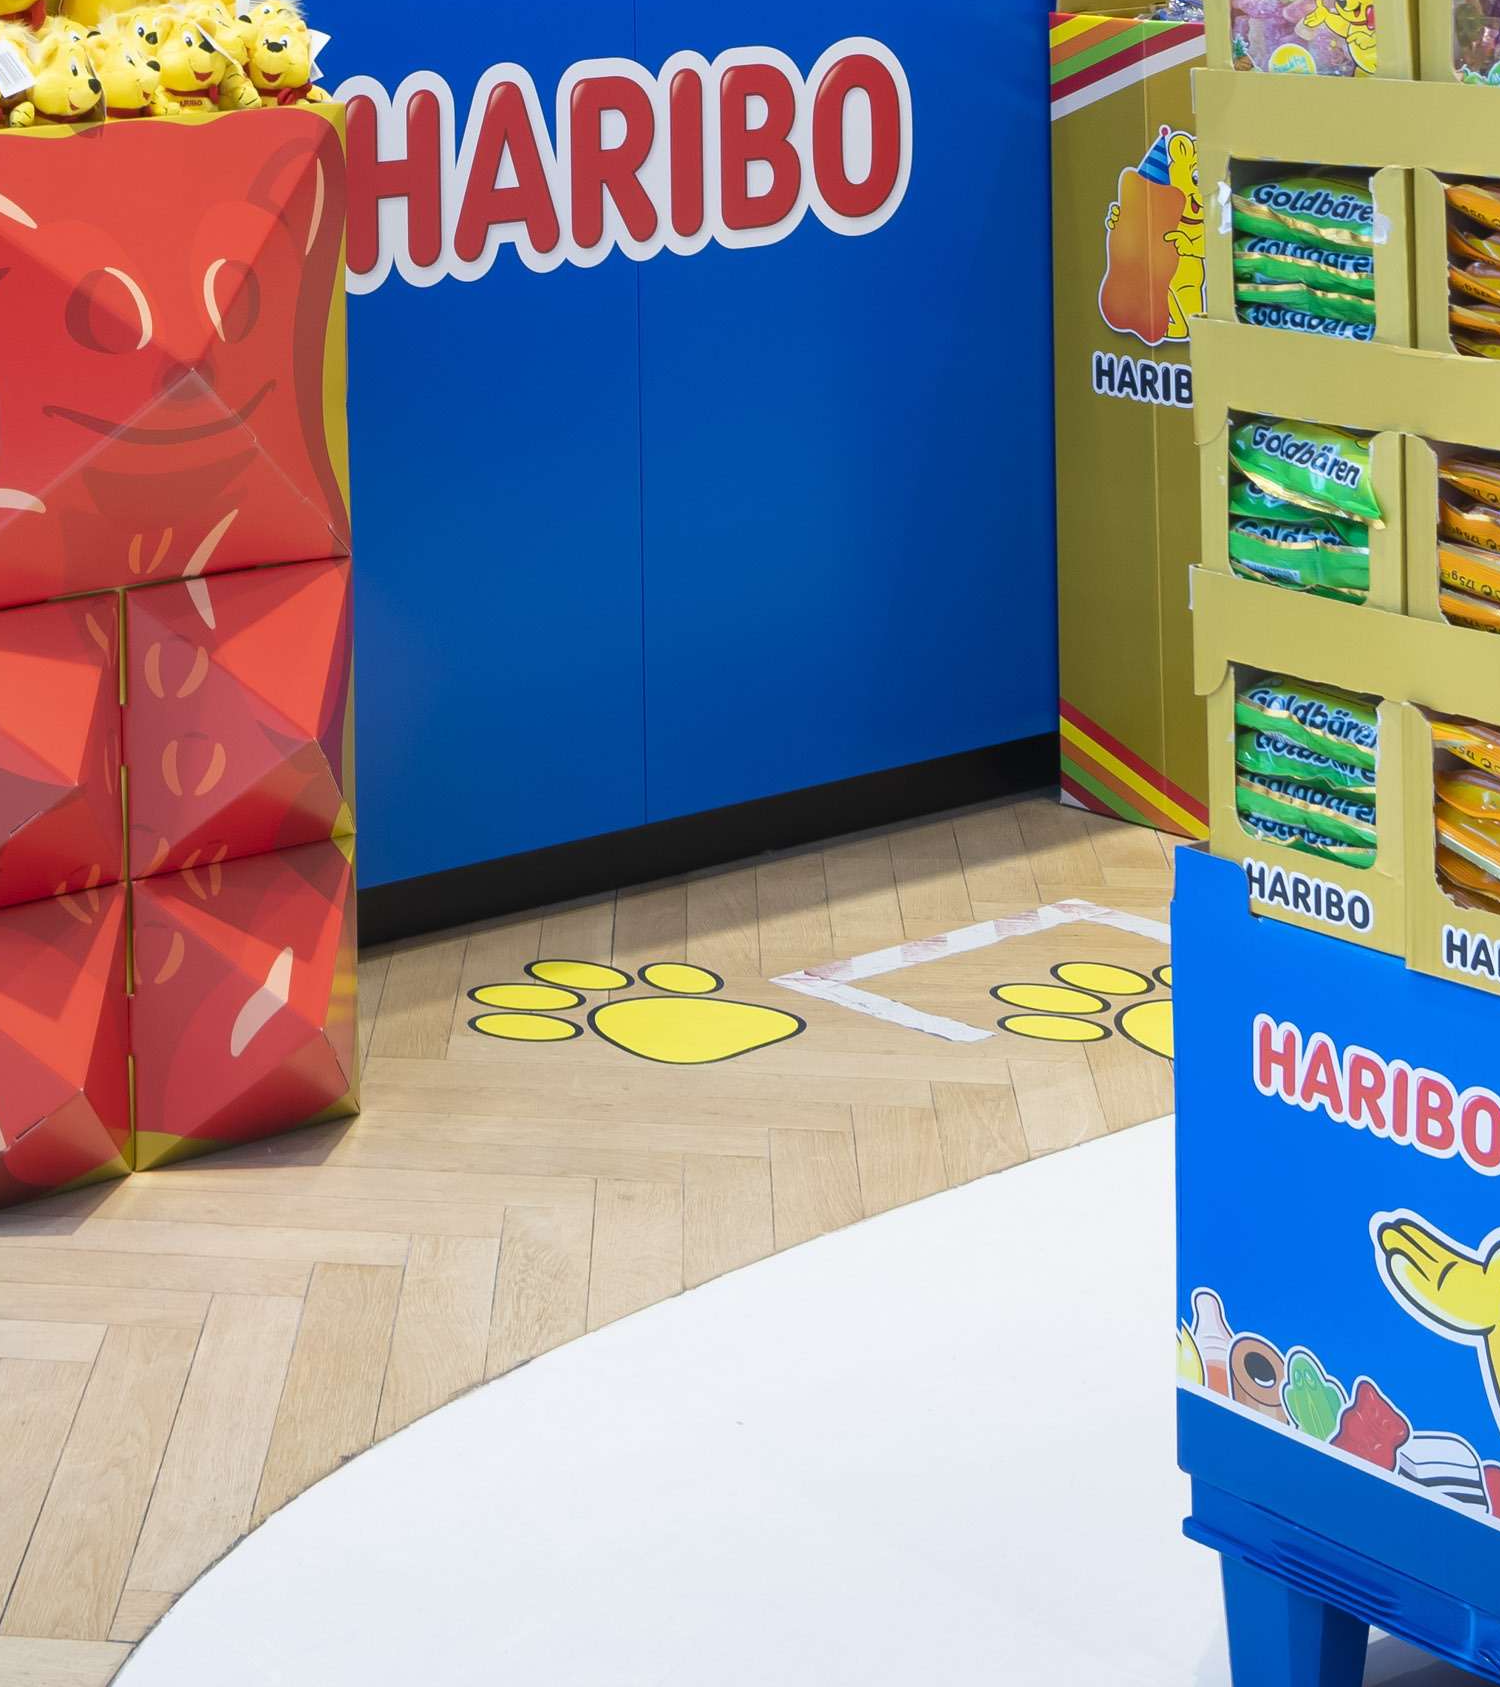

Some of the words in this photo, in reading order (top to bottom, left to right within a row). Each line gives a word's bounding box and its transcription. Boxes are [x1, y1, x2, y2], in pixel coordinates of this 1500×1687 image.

[340, 50, 905, 280] HARIBO
[1094, 353, 1193, 406] HARIB
[1253, 426, 1361, 489] Goldbären
[1246, 860, 1373, 930] HARIBO
